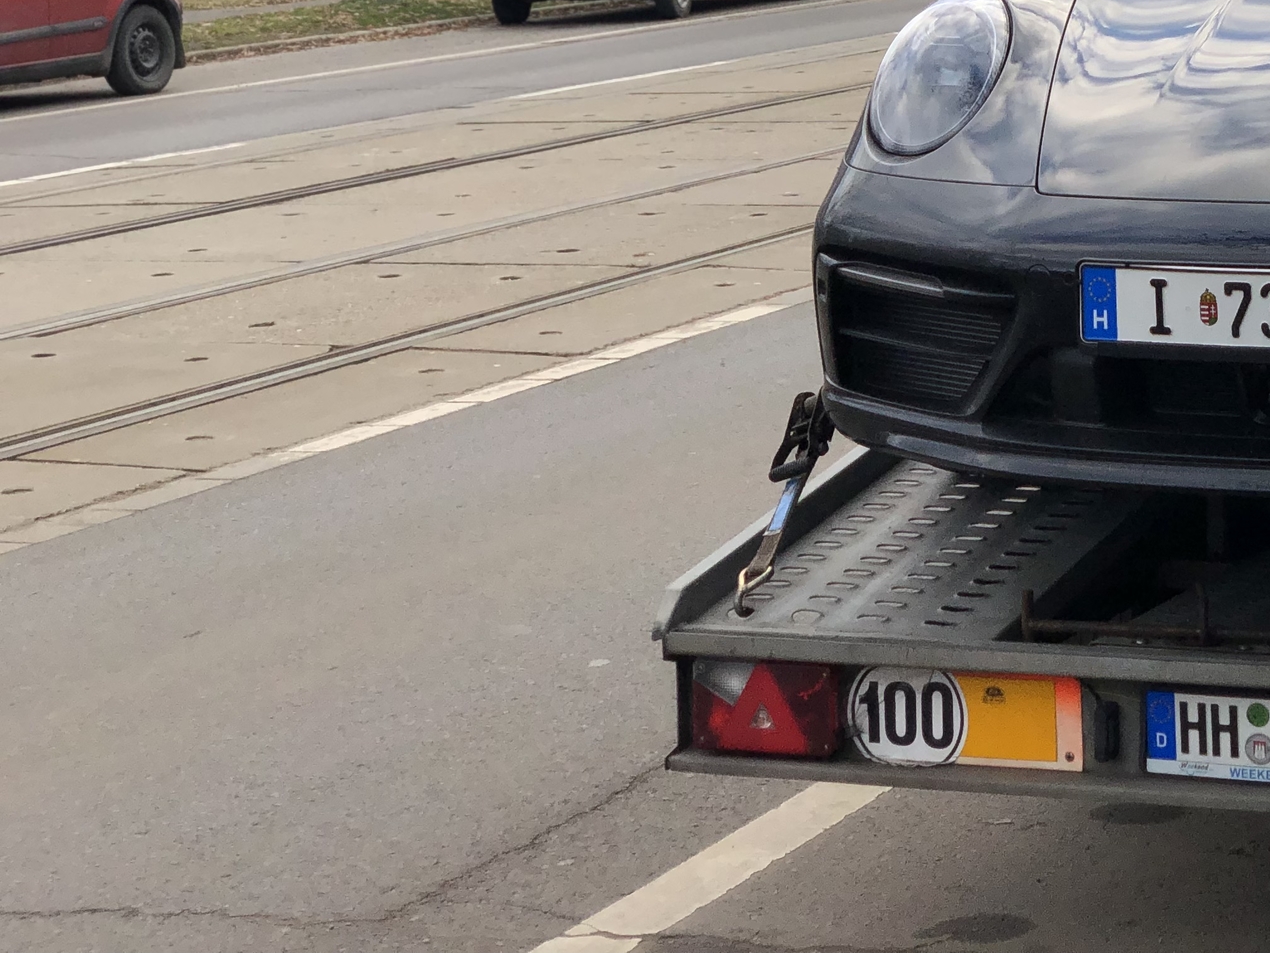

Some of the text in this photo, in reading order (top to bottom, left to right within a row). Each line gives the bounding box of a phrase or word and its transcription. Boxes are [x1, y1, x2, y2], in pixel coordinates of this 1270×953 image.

[1093, 309, 1108, 330] H
[858, 680, 956, 750] 100
[1156, 732, 1167, 748] D
[1178, 701, 1240, 758] HH
